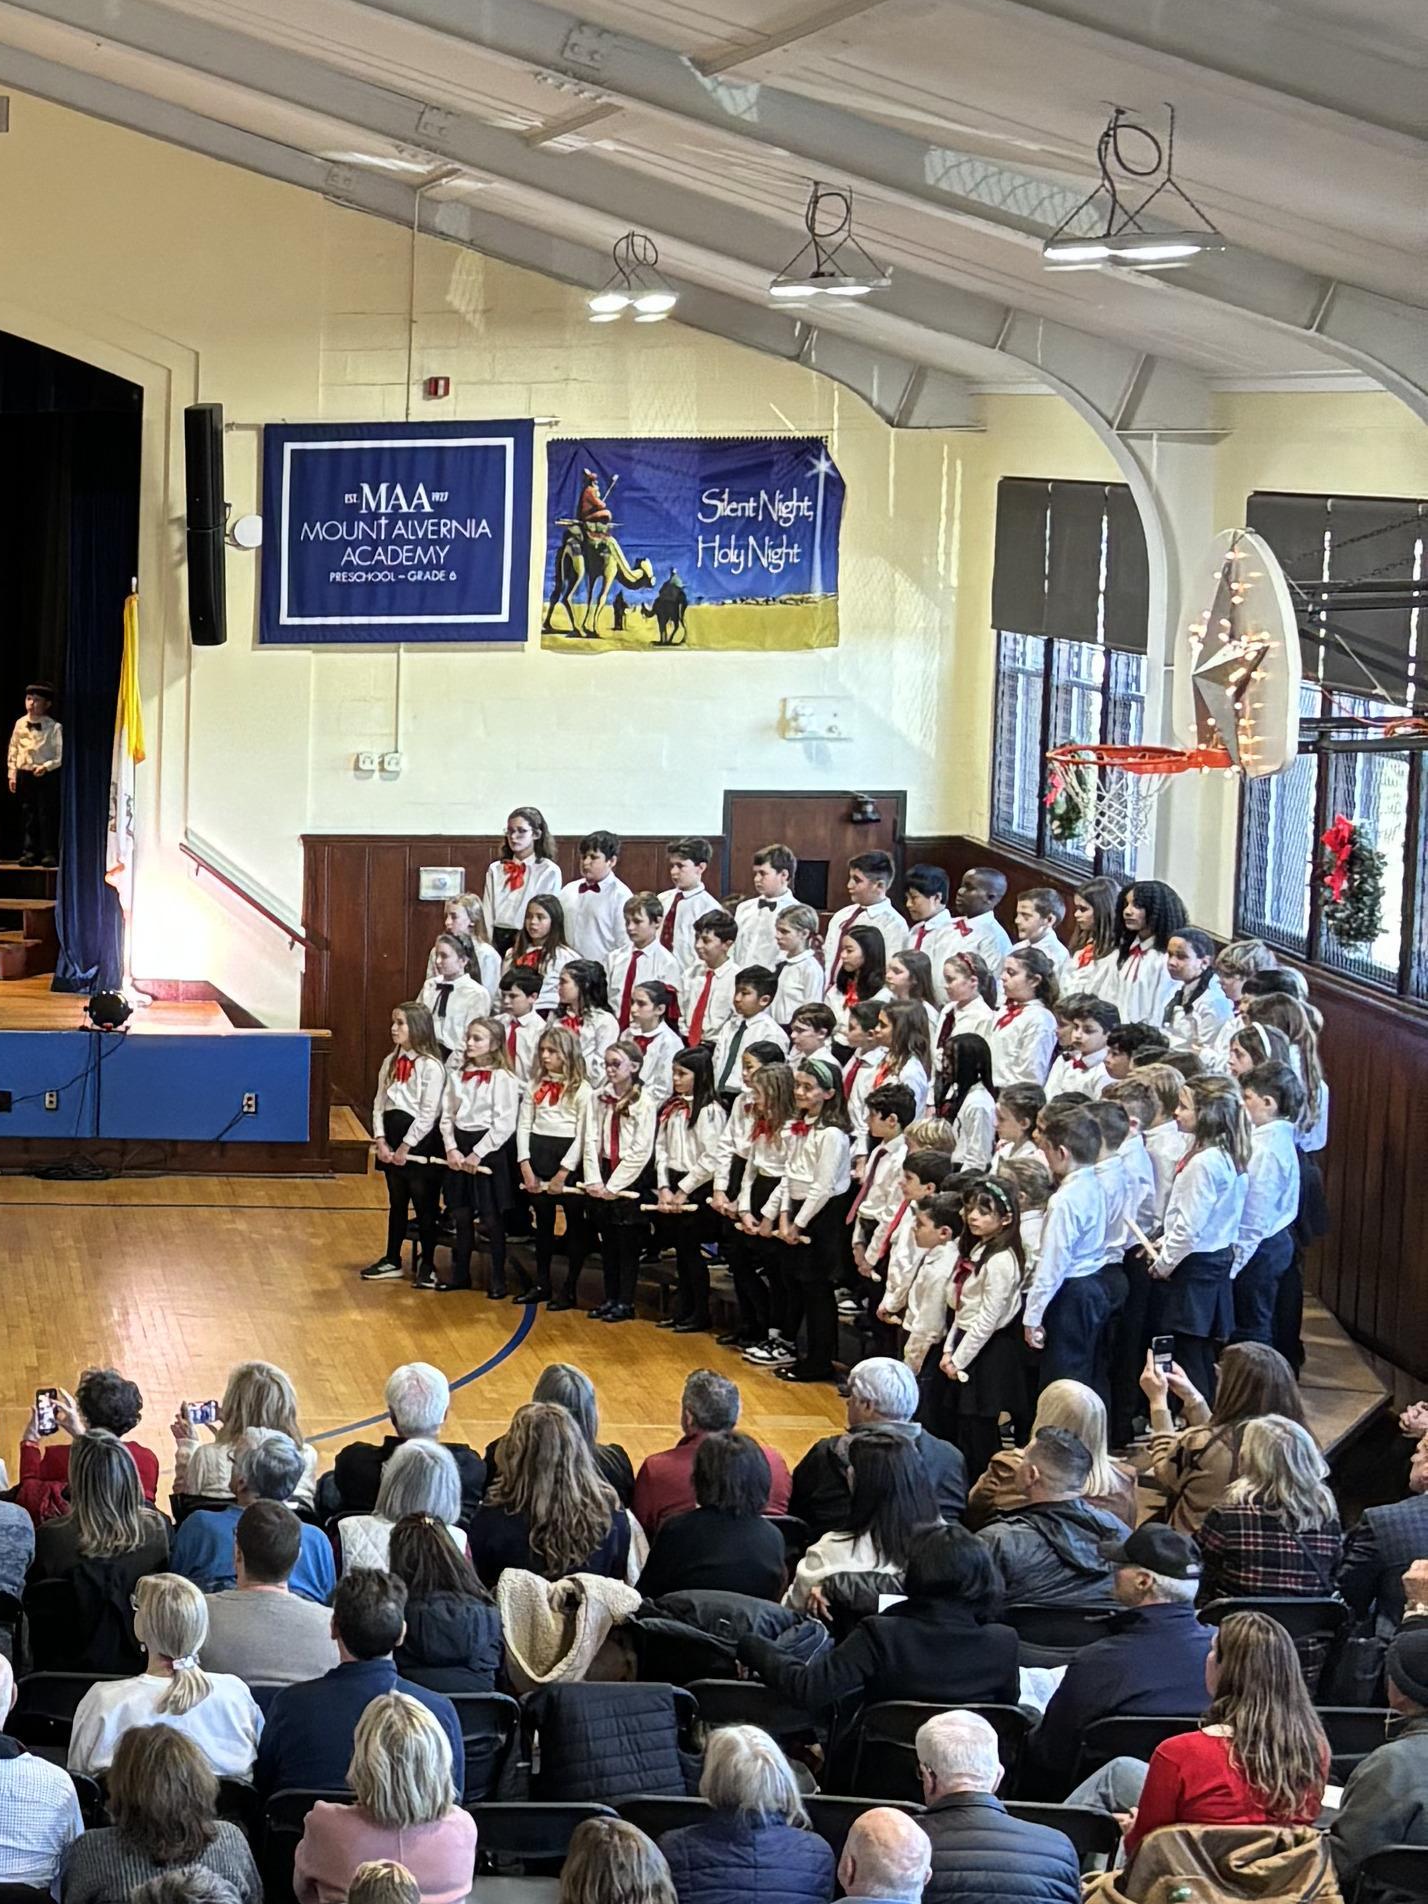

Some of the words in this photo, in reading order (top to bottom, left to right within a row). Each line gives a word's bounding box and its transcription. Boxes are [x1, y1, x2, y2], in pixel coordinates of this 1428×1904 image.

[359, 482, 434, 513] MAA
[697, 487, 757, 523] Silent
[301, 516, 389, 541] MOUNT
[392, 518, 492, 539] ALVERNIA
[341, 545, 450, 566] ACADEMY
[697, 534, 744, 574] Holy
[748, 534, 802, 573] Night
[329, 570, 395, 583] PRESCHOOL
[407, 570, 446, 582] GRADE
[449, 570, 457, 581] 6
